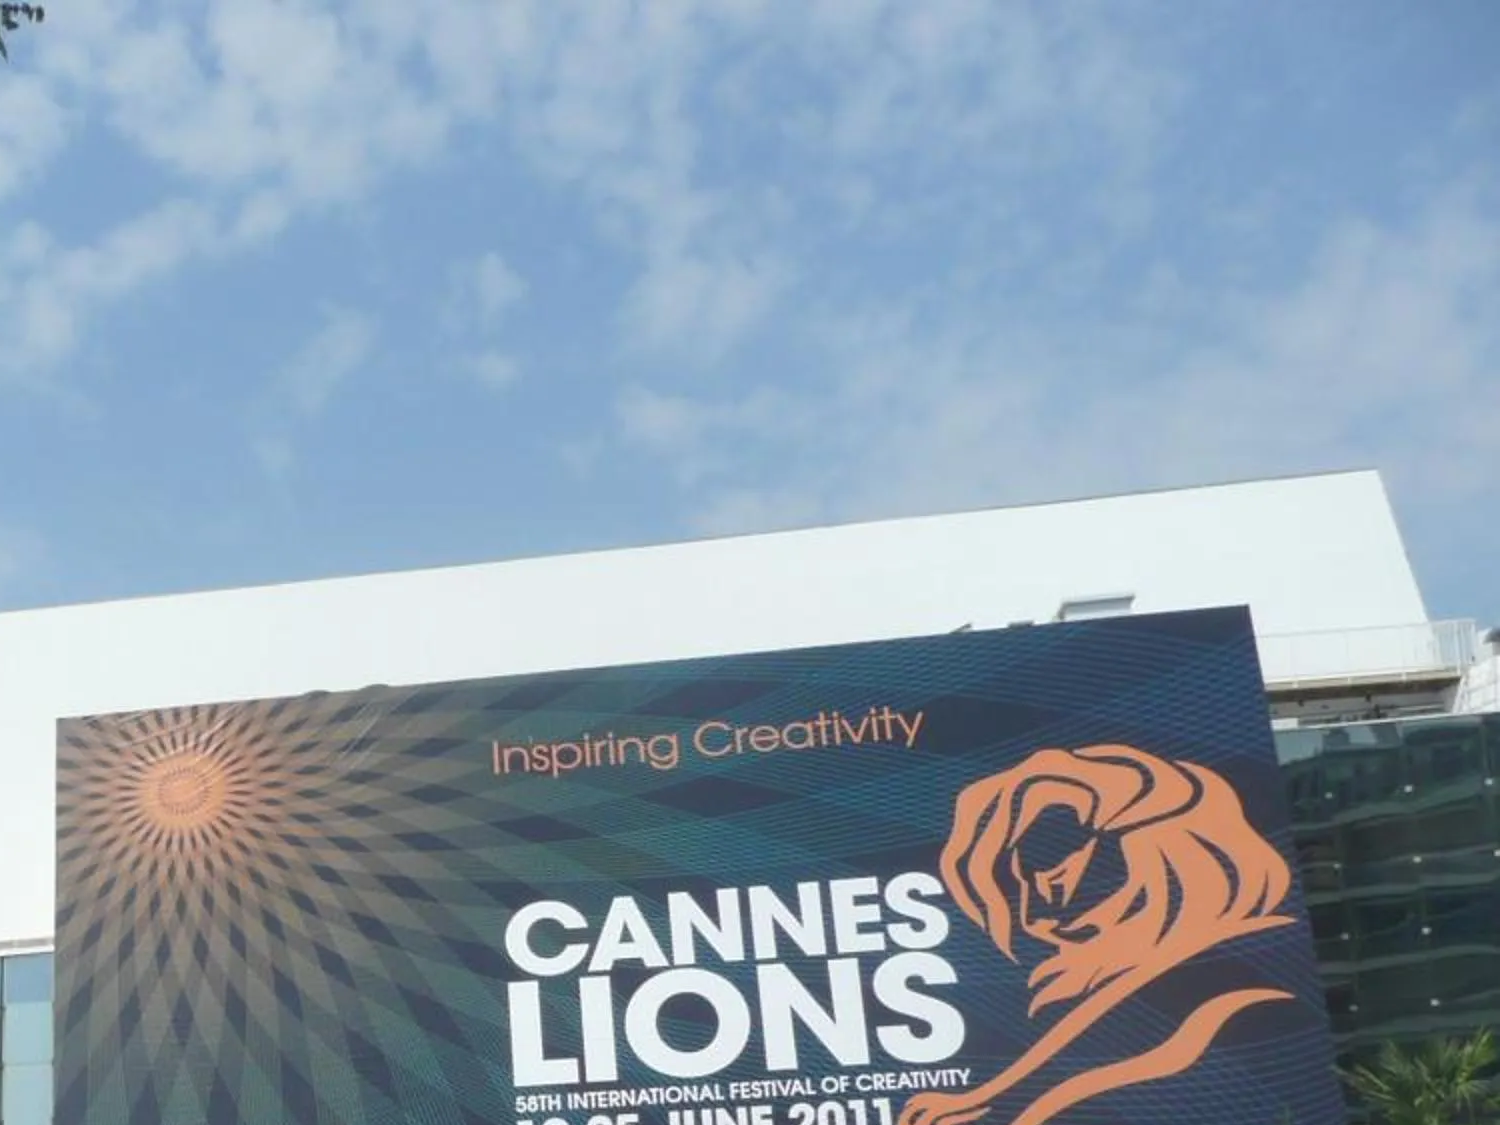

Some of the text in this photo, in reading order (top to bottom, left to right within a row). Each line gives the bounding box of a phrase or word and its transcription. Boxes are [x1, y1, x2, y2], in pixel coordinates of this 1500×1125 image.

[492, 705, 924, 778] Inspiring Creativity
[504, 871, 950, 977] CANNES
[507, 951, 966, 1087] LIONS
[515, 1068, 971, 1114] 58TH INTERNATIONAL FESTIVAL OF CREATIVITY
